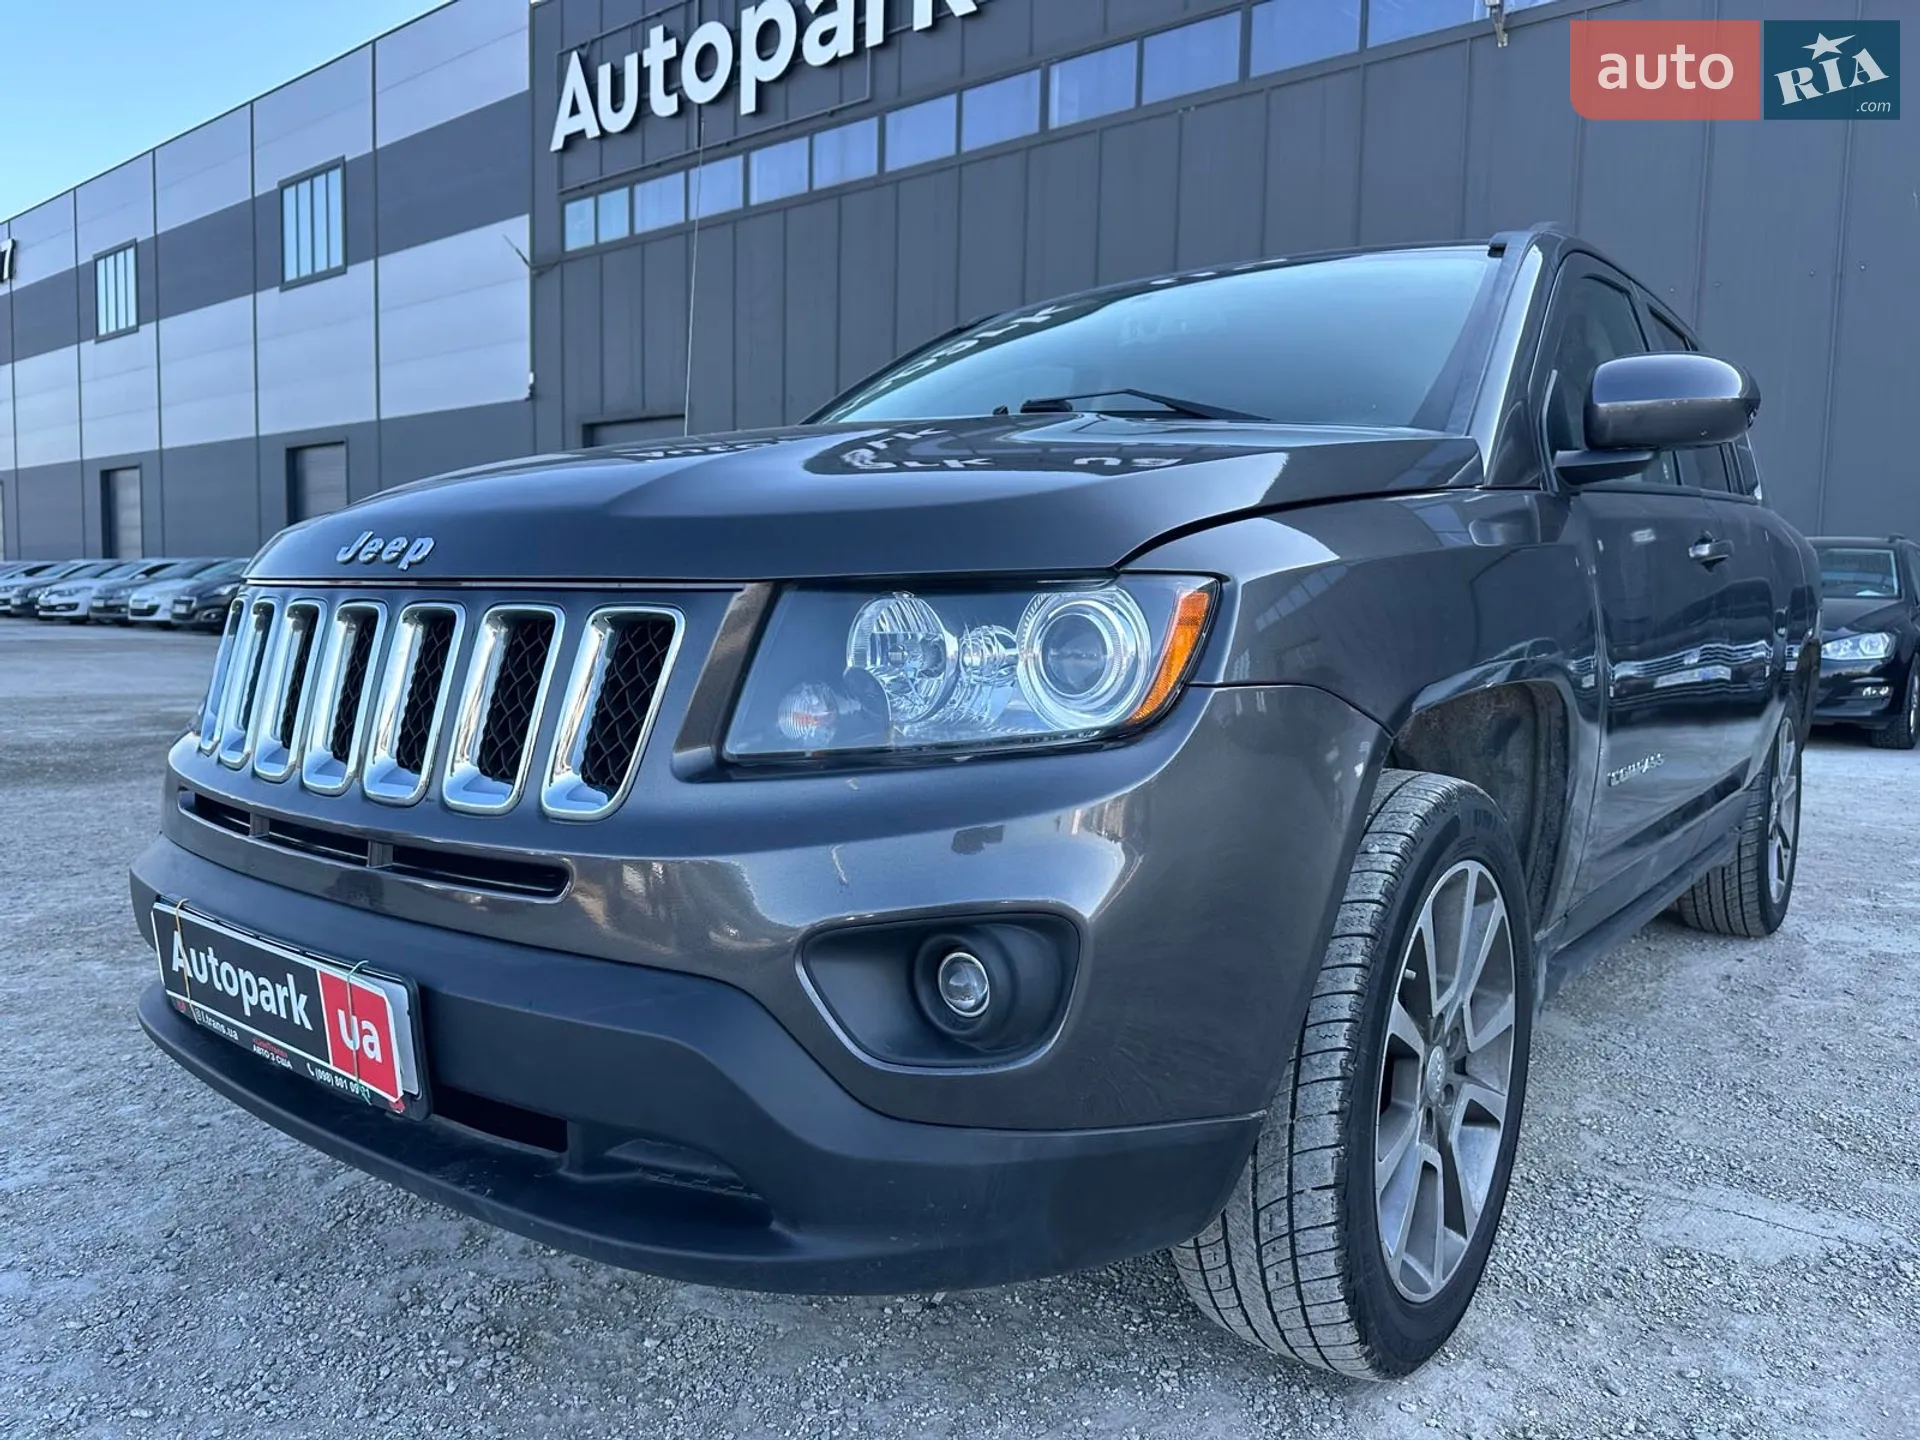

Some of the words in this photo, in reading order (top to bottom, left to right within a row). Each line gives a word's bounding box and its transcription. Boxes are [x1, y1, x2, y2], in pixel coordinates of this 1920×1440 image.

[550, 0, 977, 151] Autopa
[336, 531, 435, 570] Jeep
[172, 931, 313, 1031] Autopark
[338, 1008, 383, 1063] ua
